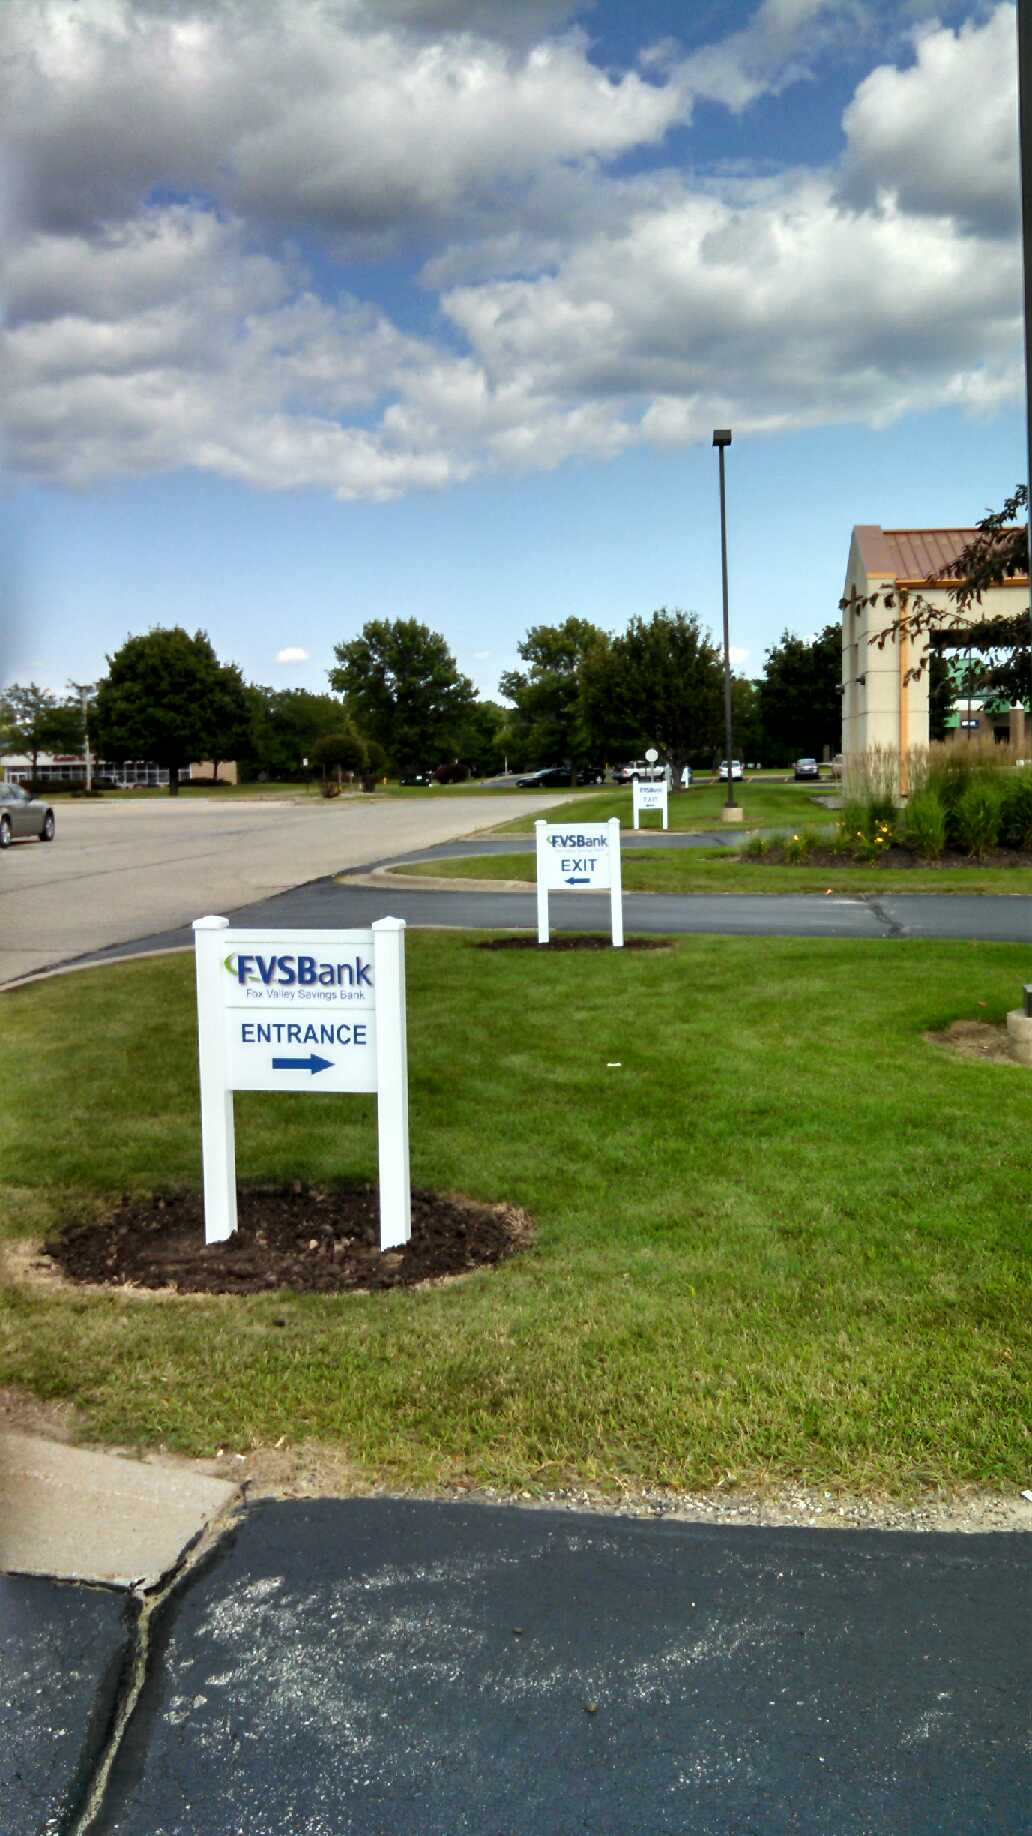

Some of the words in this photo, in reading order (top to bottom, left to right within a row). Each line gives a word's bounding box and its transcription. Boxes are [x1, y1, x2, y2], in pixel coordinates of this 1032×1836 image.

[551, 834, 608, 847] FVSBank
[561, 859, 597, 871] EXIT
[237, 955, 373, 986] FVSBank
[246, 988, 263, 998] Fox
[268, 988, 295, 1000] Valley
[298, 989, 337, 1001] Savings
[340, 990, 366, 1000] Bank
[241, 1023, 367, 1045] ENTRANCE
